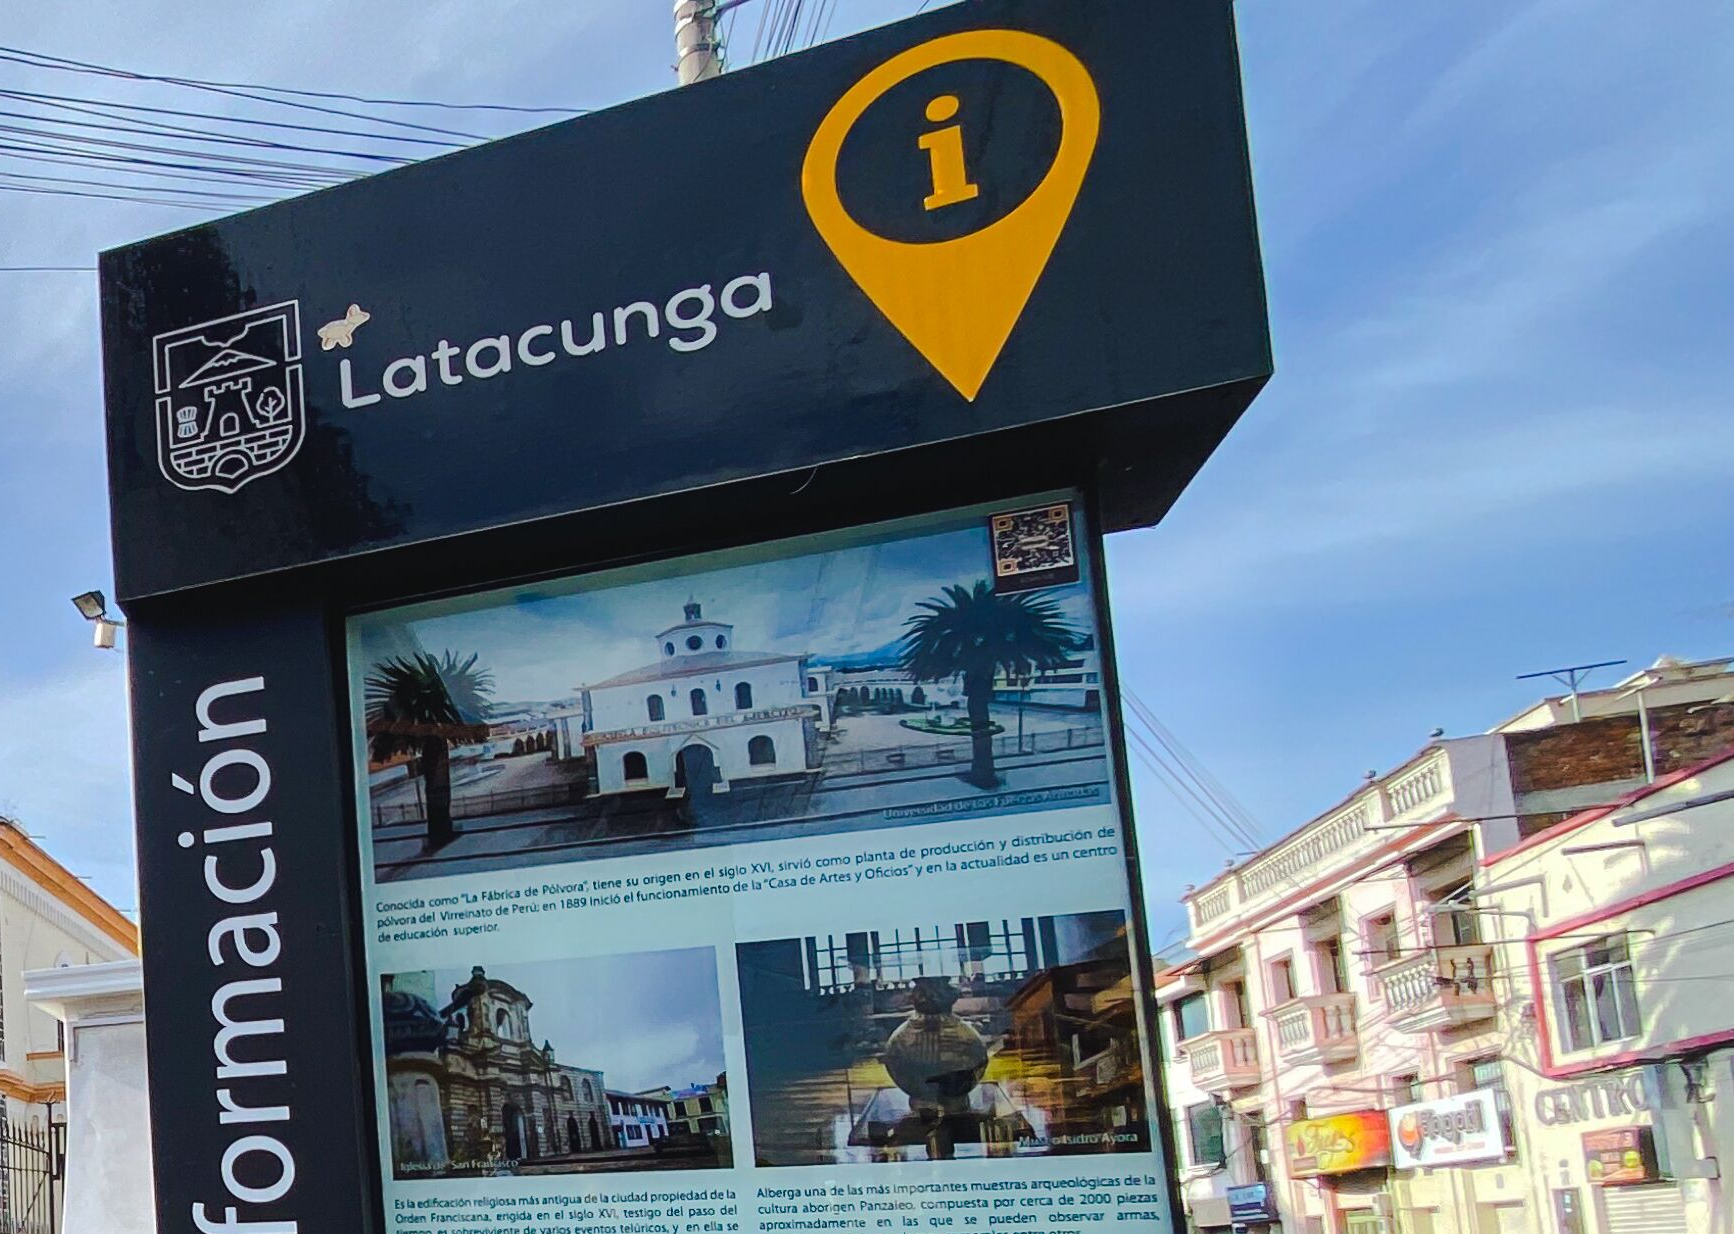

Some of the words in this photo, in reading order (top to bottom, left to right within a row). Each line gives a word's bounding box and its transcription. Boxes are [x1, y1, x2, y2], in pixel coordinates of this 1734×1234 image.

[339, 273, 773, 409] Latacunga
[375, 897, 425, 913] Conocida
[428, 896, 458, 908] como
[481, 888, 520, 902] Fábrica
[592, 878, 622, 891] tiene
[642, 872, 681, 886] origen
[718, 864, 747, 879] siglo
[778, 857, 811, 872] sirvió
[815, 856, 850, 868] como
[855, 850, 895, 866] planta
[920, 839, 994, 860] producción
[1011, 829, 1092, 848] distribución
[376, 915, 416, 931] pólvora
[418, 911, 435, 924] del
[440, 907, 492, 922] Virreinato
[560, 896, 586, 910] 1889
[589, 892, 620, 907] inició
[636, 884, 730, 903] funcionamiento
[819, 872, 851, 884] Artes
[960, 852, 1030, 870] actualidad
[1072, 846, 1116, 859] centro
[393, 926, 448, 942] educación
[756, 1186, 801, 1200] Alberga
[804, 1188, 826, 1197] una
[846, 1184, 863, 1196] las
[866, 1183, 890, 1195] más
[893, 1182, 967, 1196] importantes
[970, 1180, 1027, 1192] muestras
[1030, 1175, 1120, 1192] arqueológicas
[417, 1196, 471, 1209] edificación
[473, 1195, 516, 1209] religiosa
[518, 1194, 539, 1206] más
[542, 1193, 582, 1207] antigua
[611, 1190, 648, 1203] ciudad
[650, 1189, 708, 1205] propiedad
[757, 1202, 798, 1215] cultura
[802, 1201, 855, 1215] aborigen
[920, 1198, 988, 1211] compuesta
[993, 1198, 1015, 1210] por
[1019, 1197, 1053, 1207] cerca
[1079, 1192, 1112, 1205] 2000
[1116, 1192, 1158, 1206] piezas
[394, 1212, 426, 1224] Orden
[496, 1209, 532, 1224] erigida
[568, 1208, 594, 1222] siglo
[622, 1206, 662, 1220] testigo
[666, 1205, 684, 1217] del
[688, 1207, 715, 1219] paso
[719, 1204, 737, 1216] del
[758, 1217, 866, 1233] aproximadamente
[902, 1215, 919, 1227] las
[928, 1217, 953, 1229] que
[988, 1212, 1037, 1227] pueden
[1048, 1211, 1104, 1223] observar
[574, 1224, 616, 1234] eventos
[703, 1220, 723, 1232] ella
